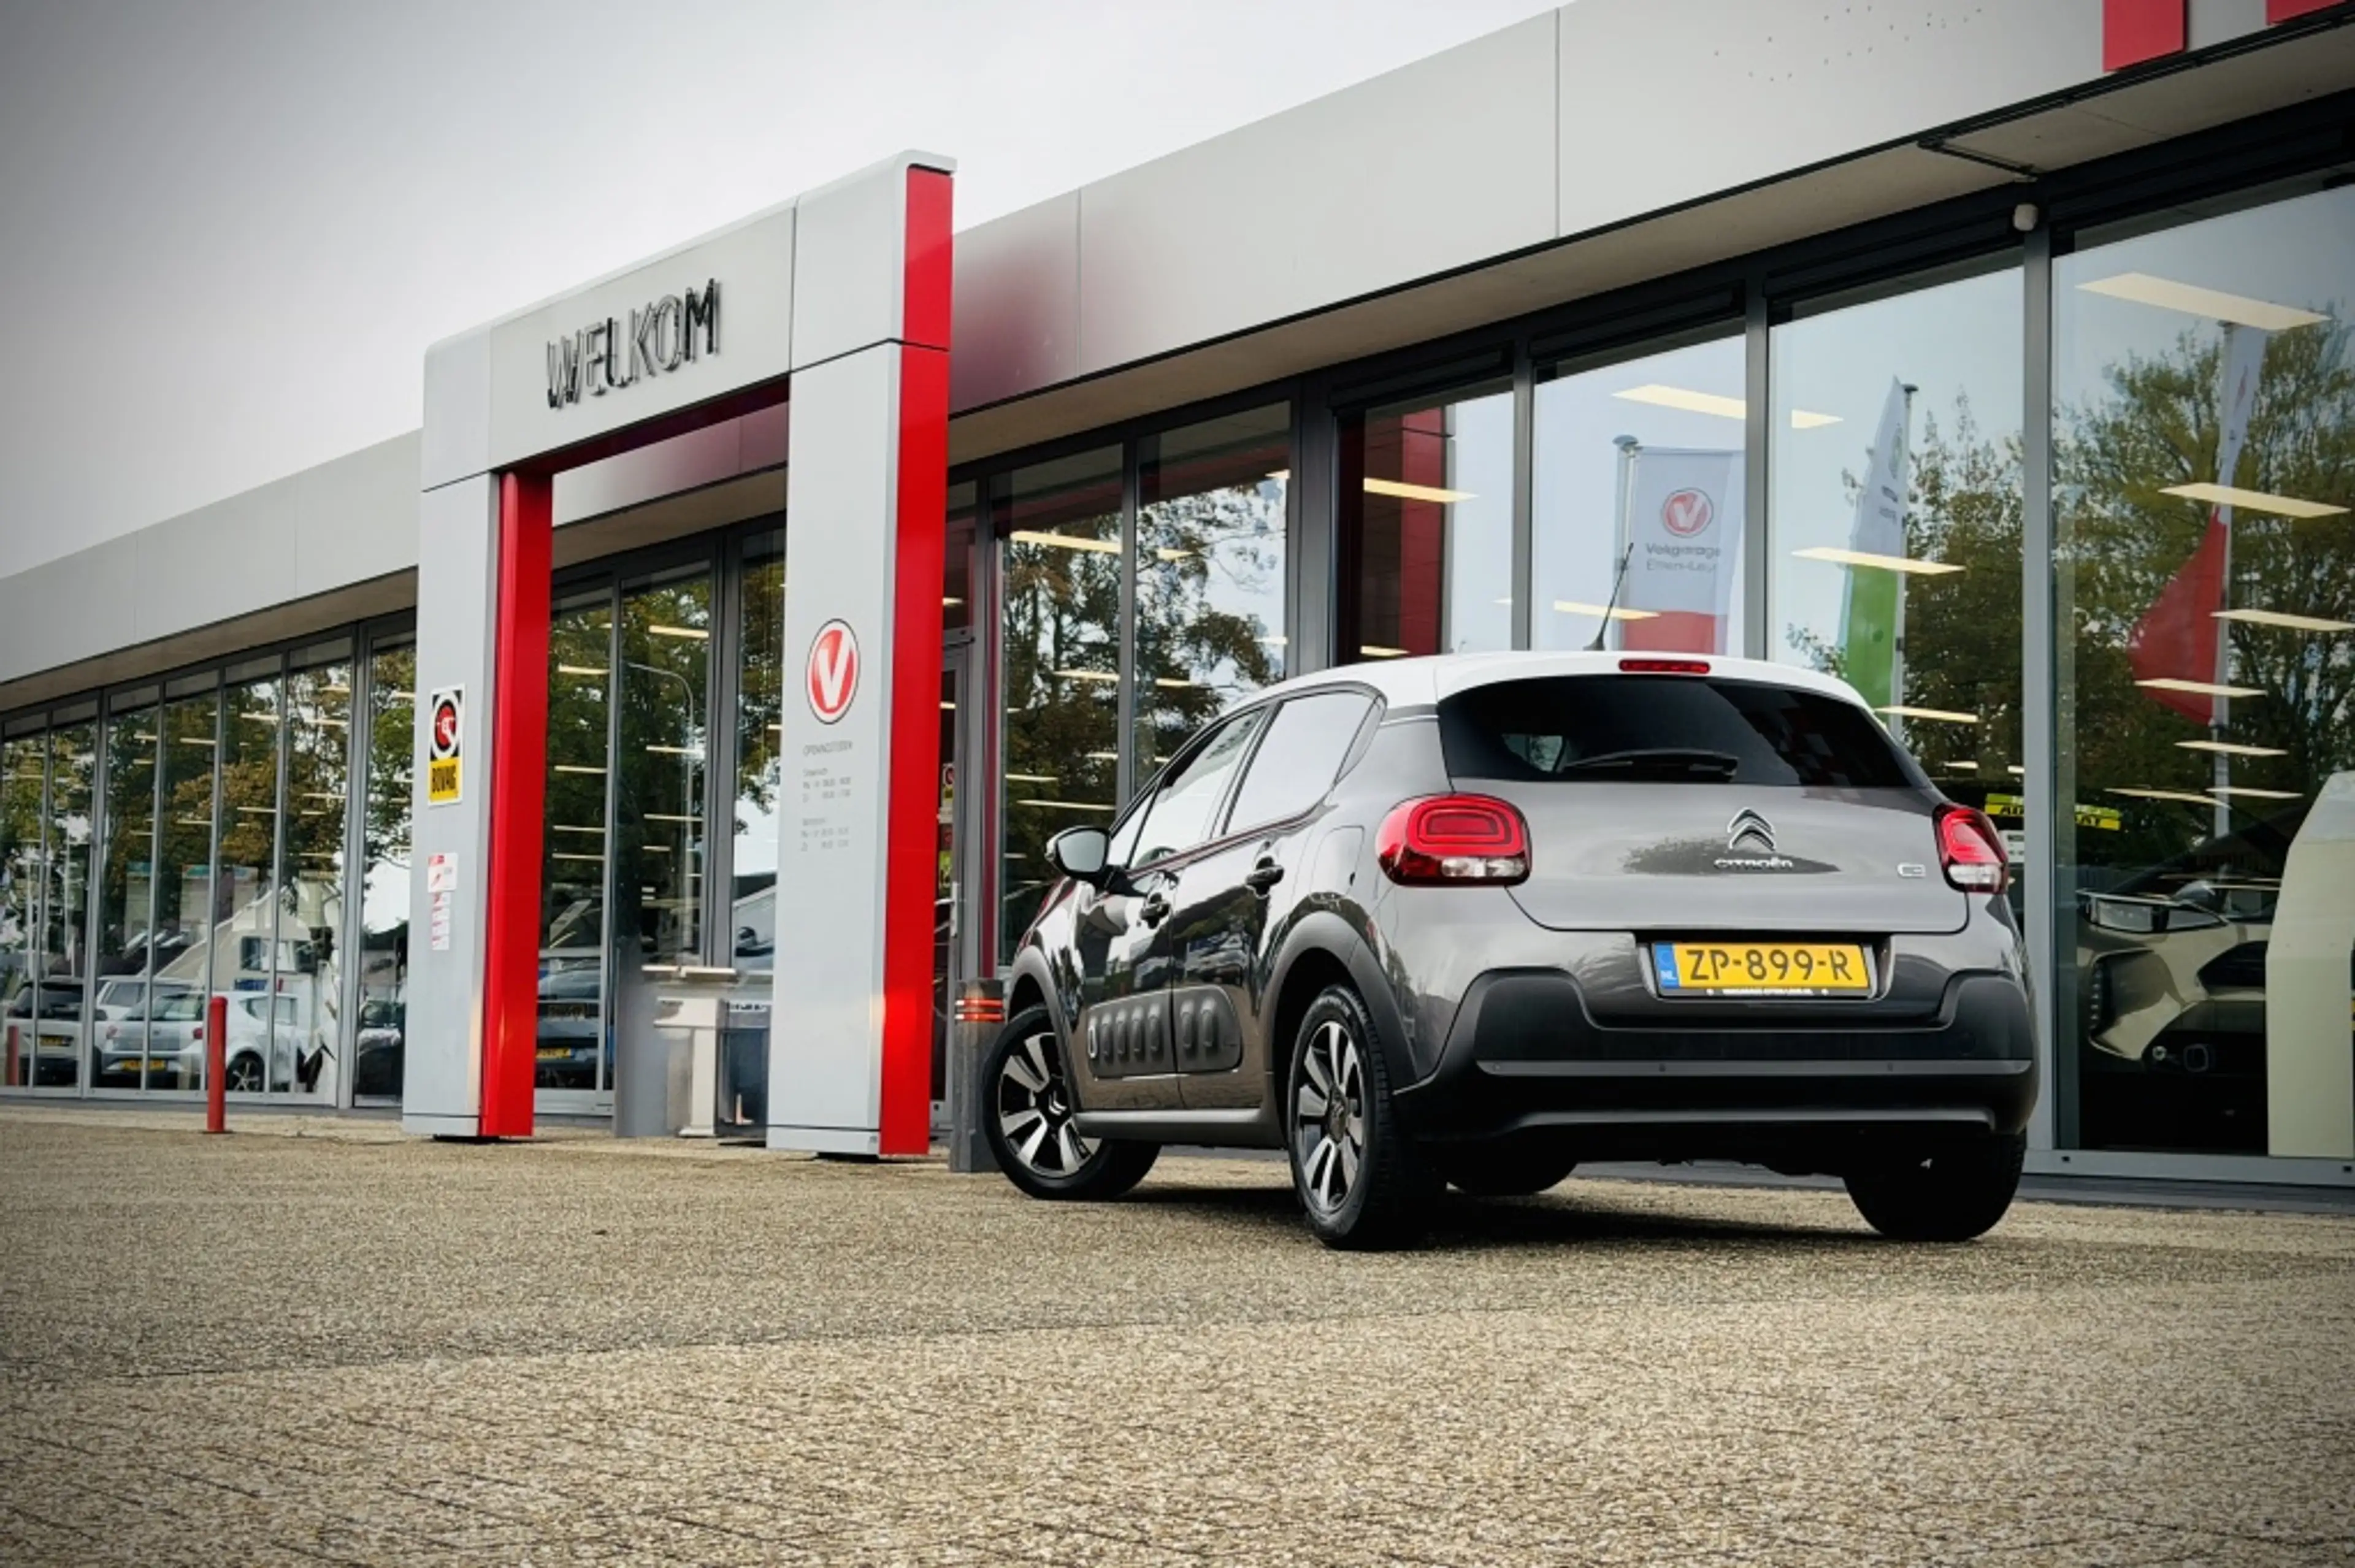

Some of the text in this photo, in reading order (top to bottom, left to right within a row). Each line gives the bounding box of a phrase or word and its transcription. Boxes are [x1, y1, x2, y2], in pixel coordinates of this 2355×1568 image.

[547, 278, 722, 410] WELKOM
[1661, 970, 1677, 981] NL
[1687, 949, 1853, 981] ZP-899-R
